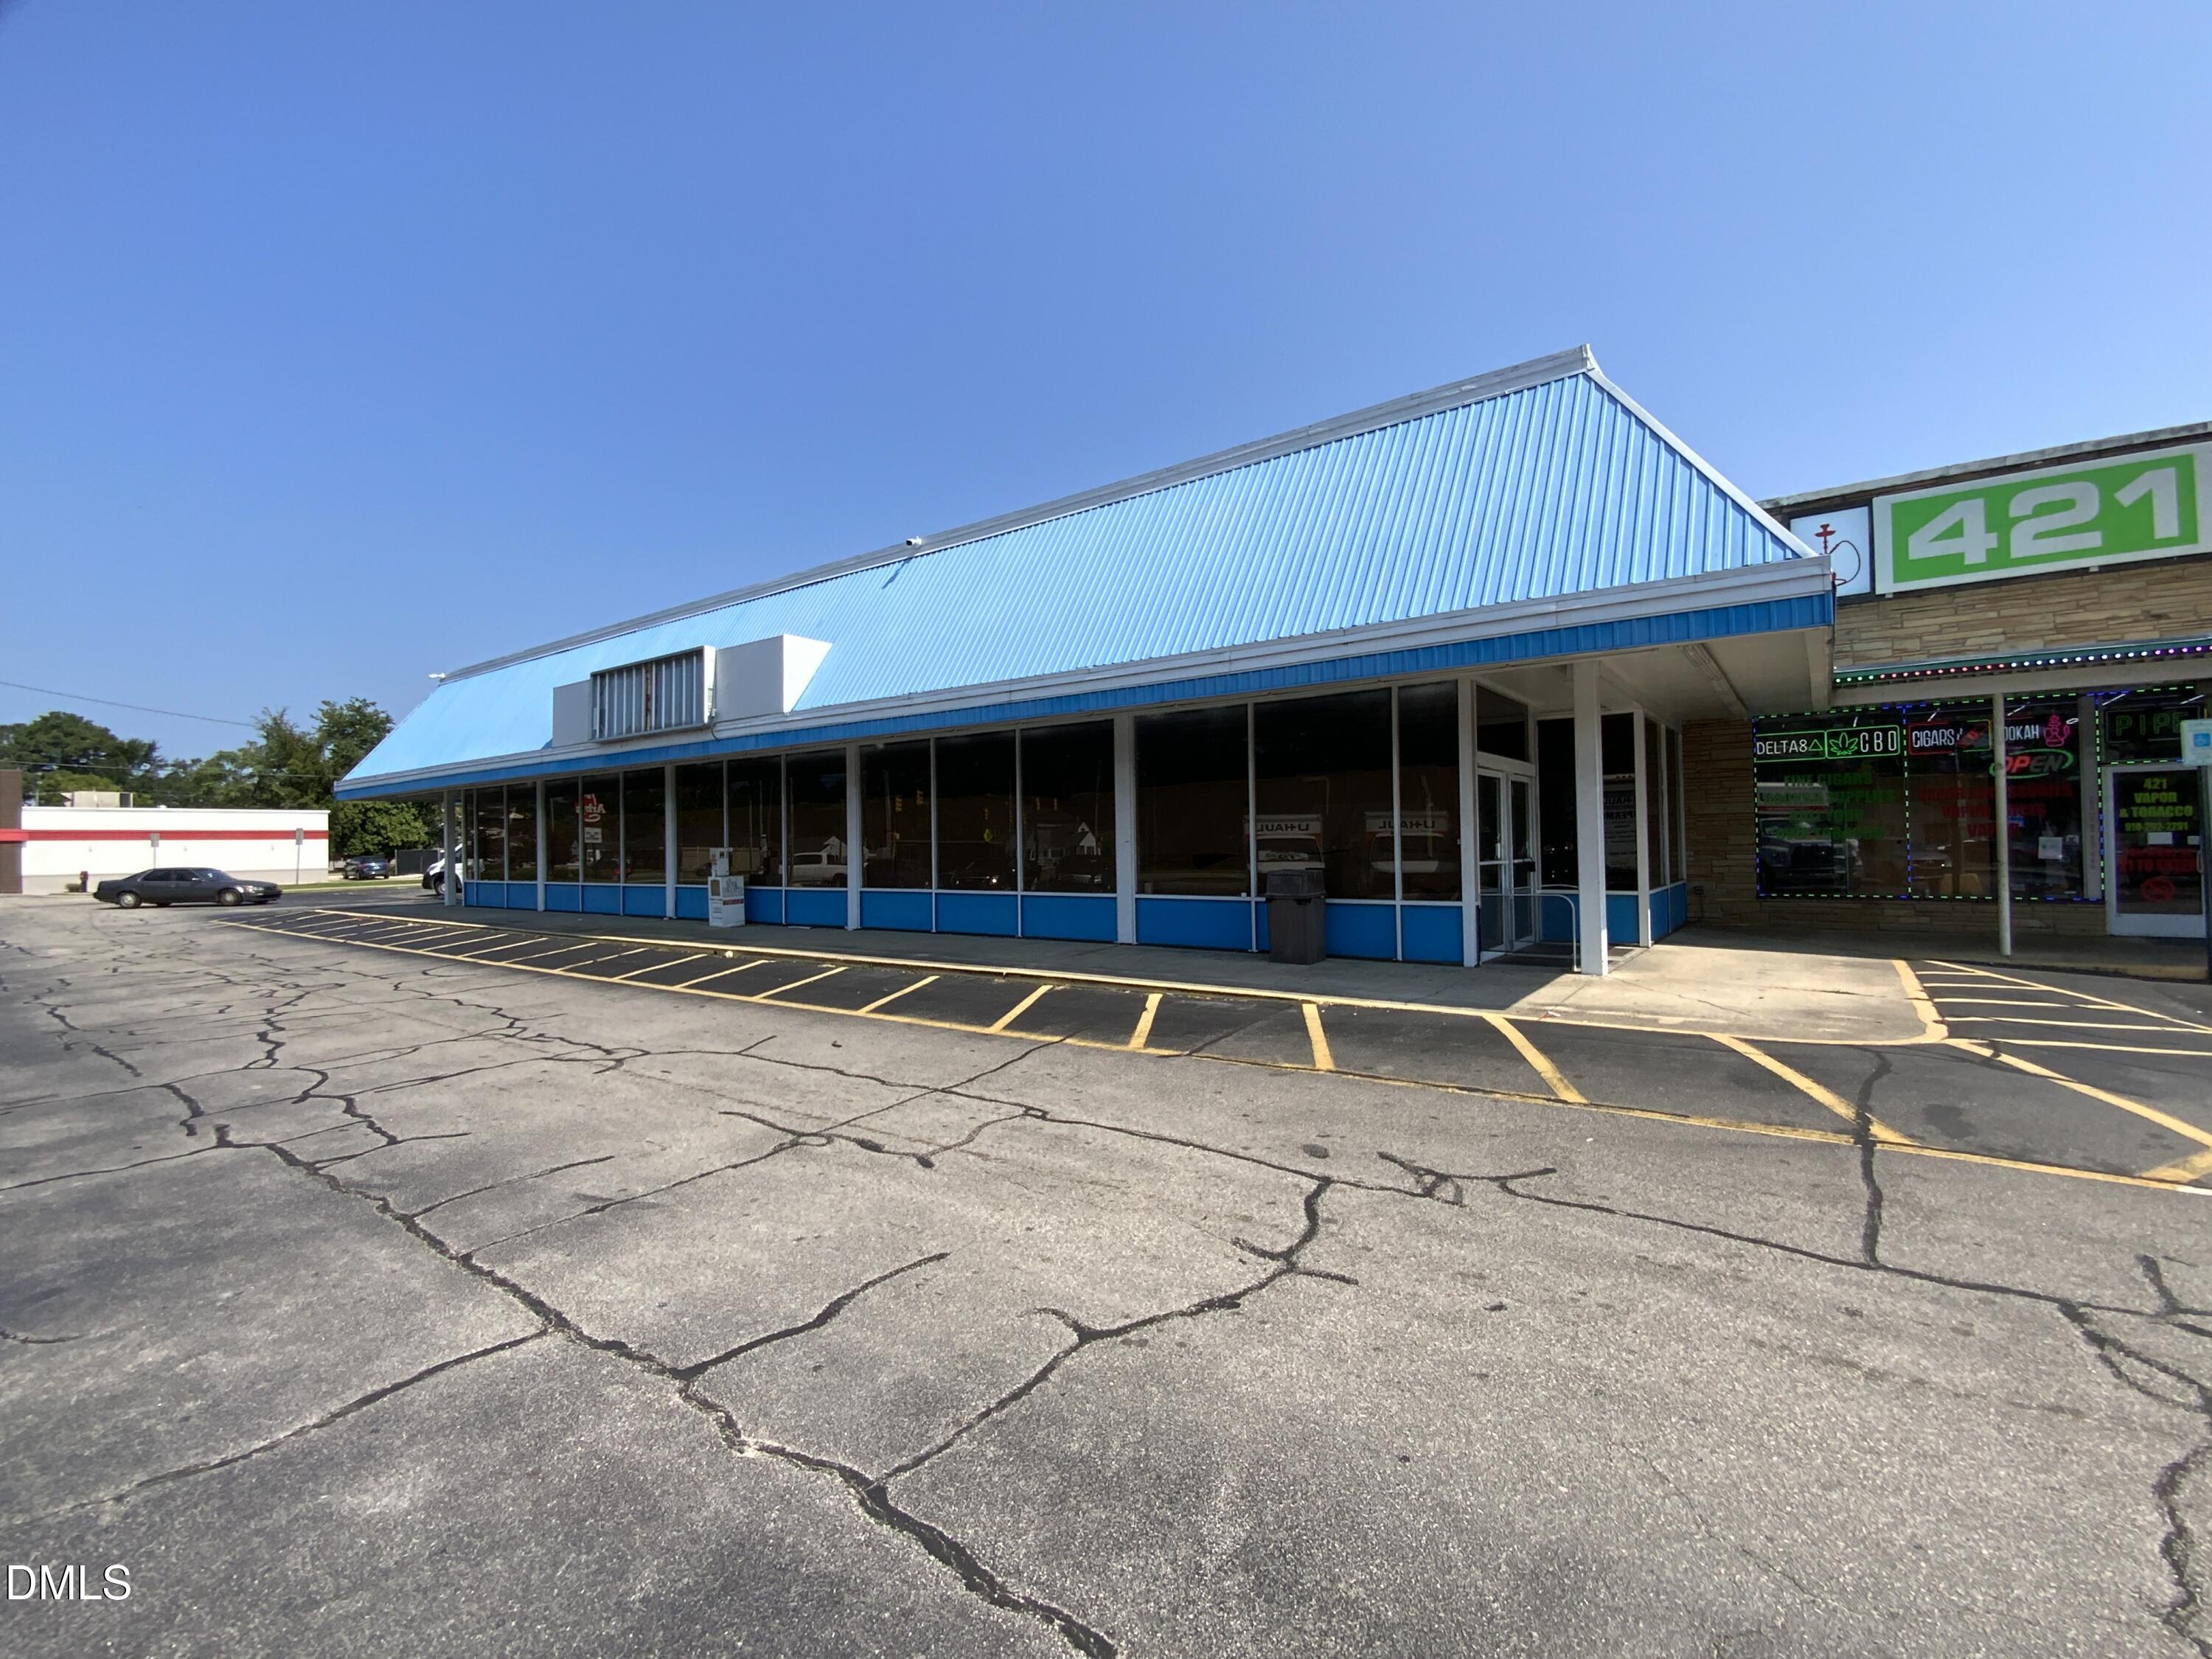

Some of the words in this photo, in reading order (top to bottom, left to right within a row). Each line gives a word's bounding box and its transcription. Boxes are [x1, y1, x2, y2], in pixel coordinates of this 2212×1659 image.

[1907, 467, 2180, 566] 421
[1912, 728, 1955, 748] CIGARS
[2004, 724, 2040, 742] OKAH
[2143, 778, 2167, 790] 421
[2133, 792, 2177, 804] VAPOR
[2130, 805, 2194, 818] TOBACCO
